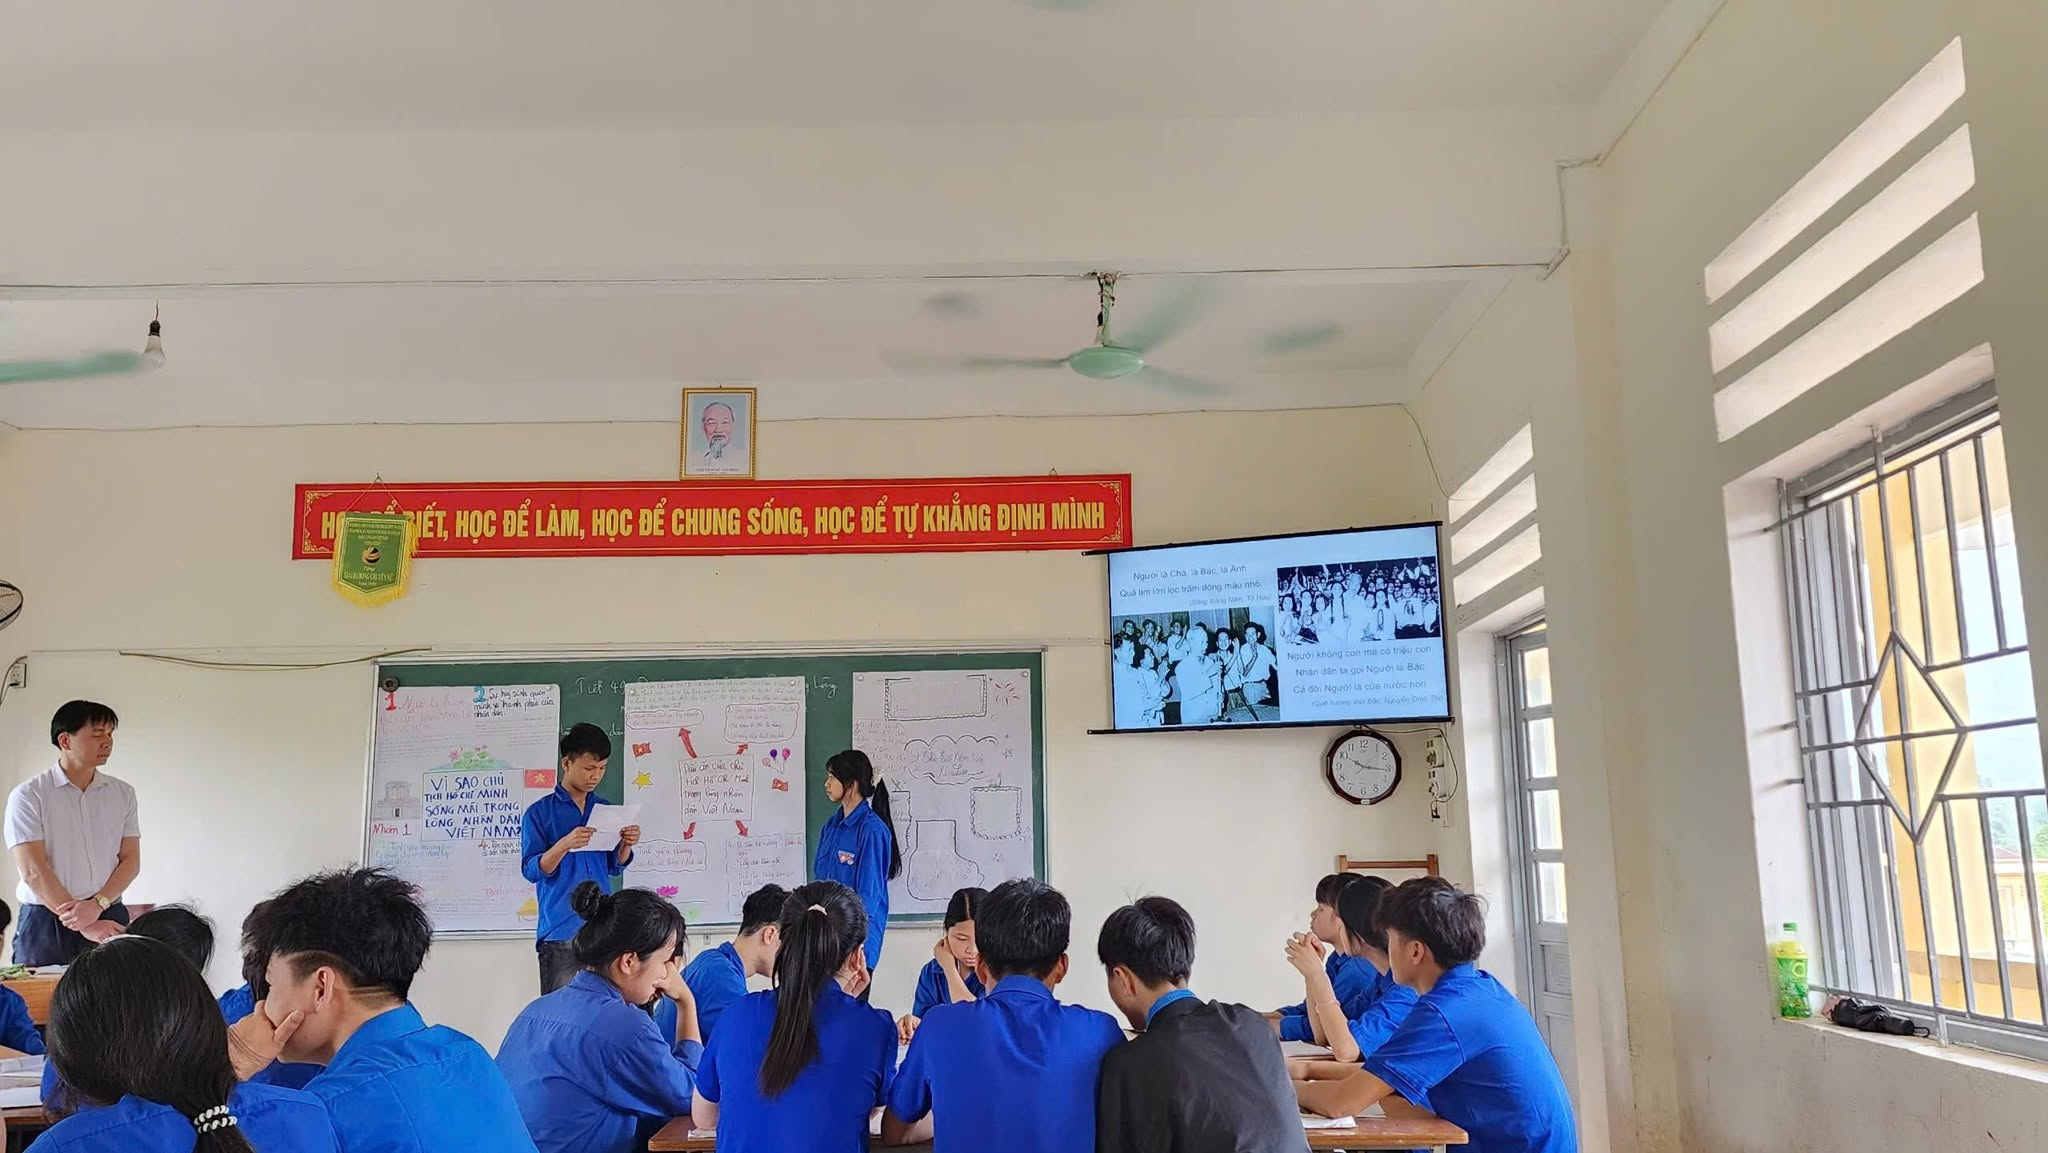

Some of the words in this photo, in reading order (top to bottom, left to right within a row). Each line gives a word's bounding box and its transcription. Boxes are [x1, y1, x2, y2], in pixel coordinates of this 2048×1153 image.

[455, 509, 496, 544] HỌC
[503, 498, 532, 537] ĐỂ
[535, 503, 585, 541] LÀM,
[591, 508, 633, 543] HỌC
[639, 497, 667, 537] ĐỂ
[671, 507, 741, 537] CHUNG
[747, 497, 809, 538] SỐNG,
[815, 506, 855, 540] HỌC
[861, 494, 888, 534] ĐỂ
[892, 502, 919, 539] TỰ
[923, 492, 991, 532] KHẲNG
[997, 502, 1046, 537] ĐỊNH
[1051, 496, 1105, 530] MÌNH
[1348, 743, 1354, 752] 11
[1360, 739, 1369, 749] 12
[1375, 743, 1379, 752] 1
[1381, 752, 1388, 760] 2
[1336, 762, 1343, 771] 9
[1339, 774, 1346, 782] 8
[454, 776, 479, 791] SAO
[1347, 782, 1354, 791] 7
[1360, 787, 1367, 796] 6
[1372, 784, 1379, 793] 5
[483, 801, 519, 814] TRONG
